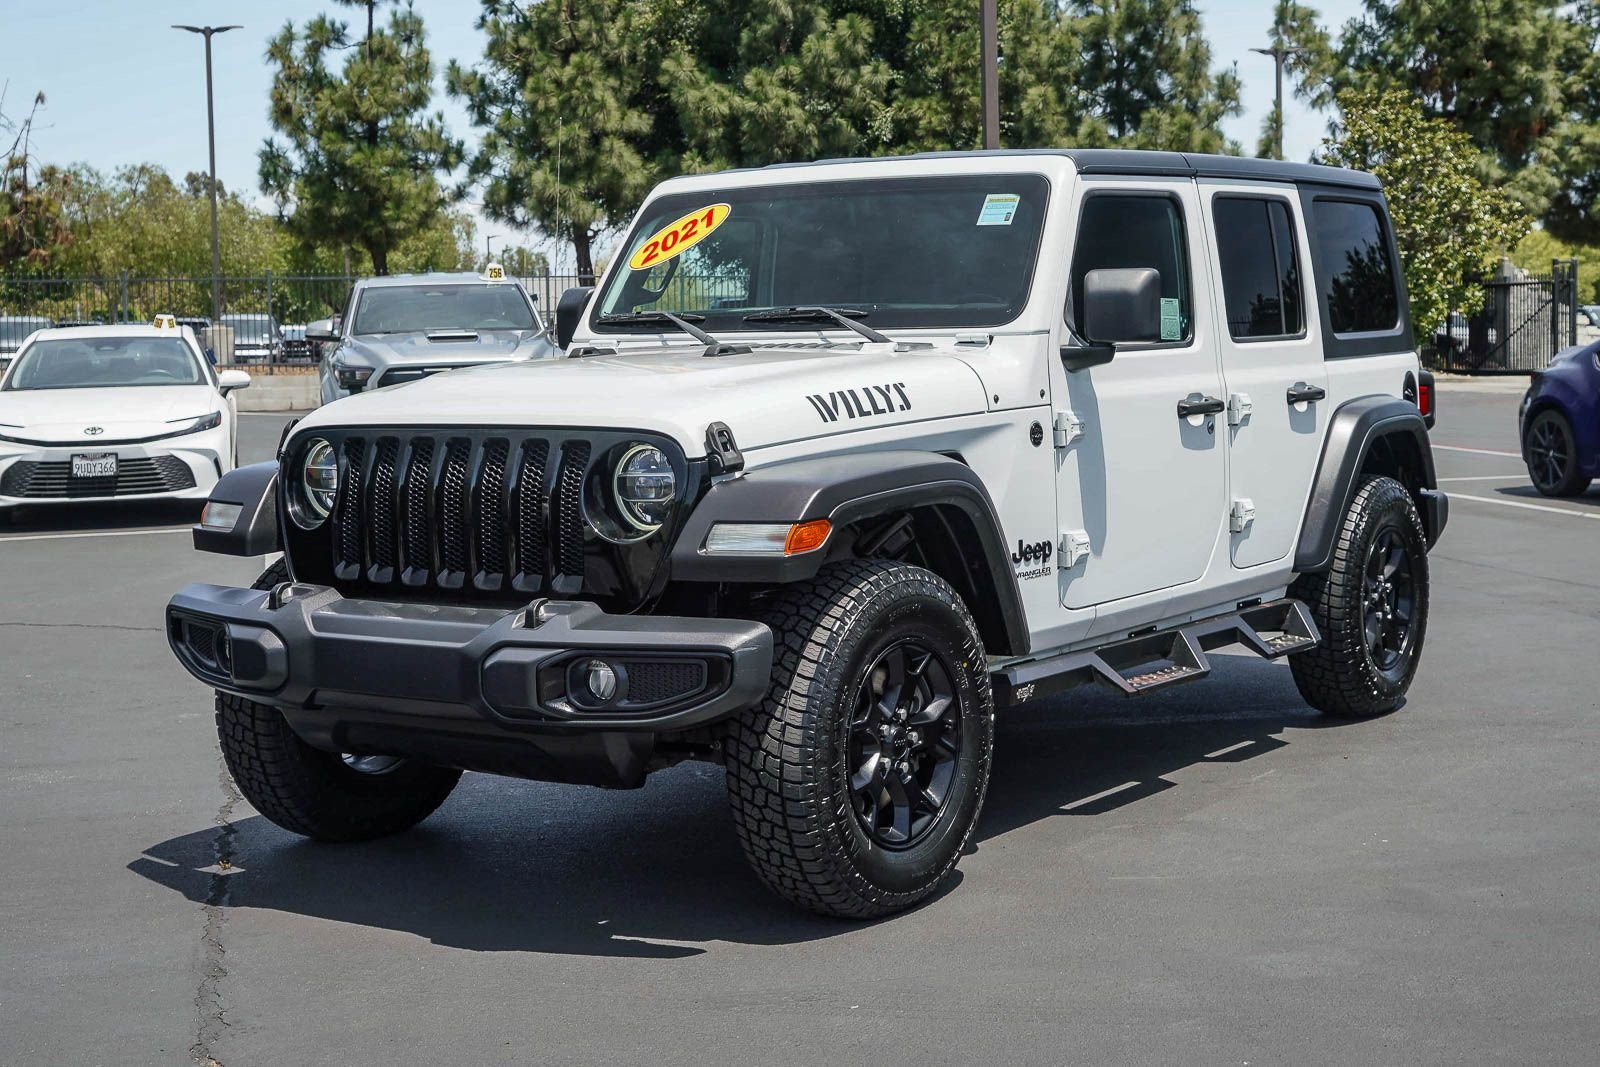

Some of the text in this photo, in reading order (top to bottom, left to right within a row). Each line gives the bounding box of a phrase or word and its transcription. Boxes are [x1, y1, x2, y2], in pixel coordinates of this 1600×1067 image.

[641, 208, 715, 266] 2021
[489, 268, 502, 278] 256
[805, 382, 912, 423] WILLYS
[1011, 539, 1053, 564] Jeep
